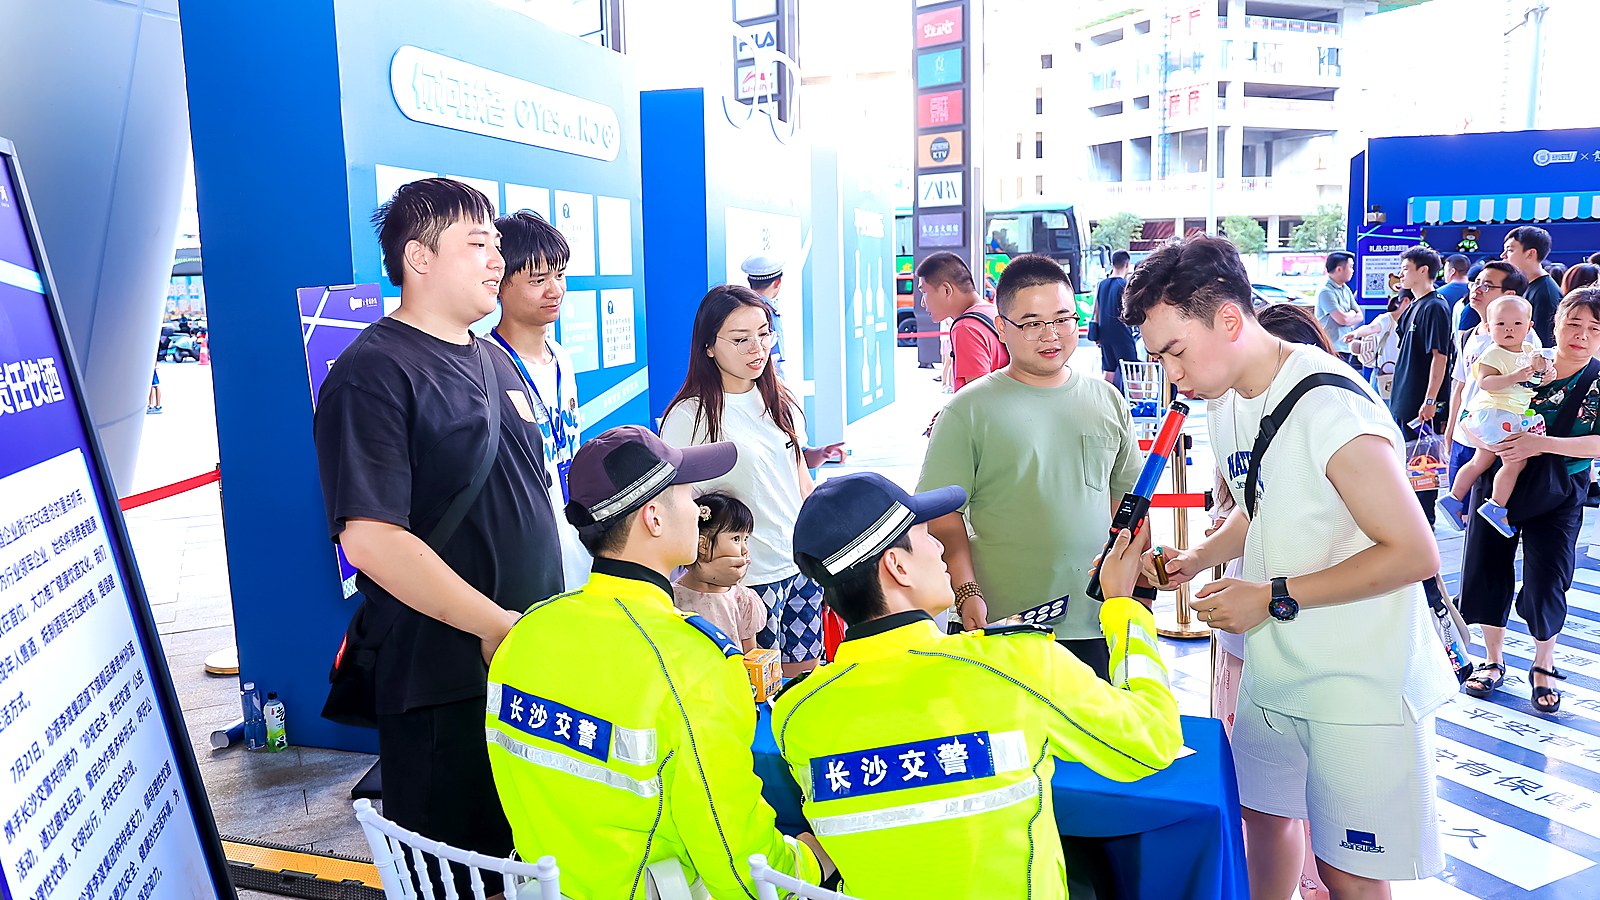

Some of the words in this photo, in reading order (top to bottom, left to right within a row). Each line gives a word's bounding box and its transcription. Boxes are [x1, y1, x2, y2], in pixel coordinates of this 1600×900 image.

[933, 150, 947, 159] KTV
[924, 180, 957, 200] ZARA
[0, 545, 107, 639] 在首位，大力推广健康饮酒文化。我们
[510, 694, 598, 750] 长沙交警
[825, 736, 969, 792] 长沙交警
[29, 759, 137, 900] 理性饮酒、文明出行，共筑安全防线。
[107, 788, 180, 900] 更加安全、健康的生活环境，为
